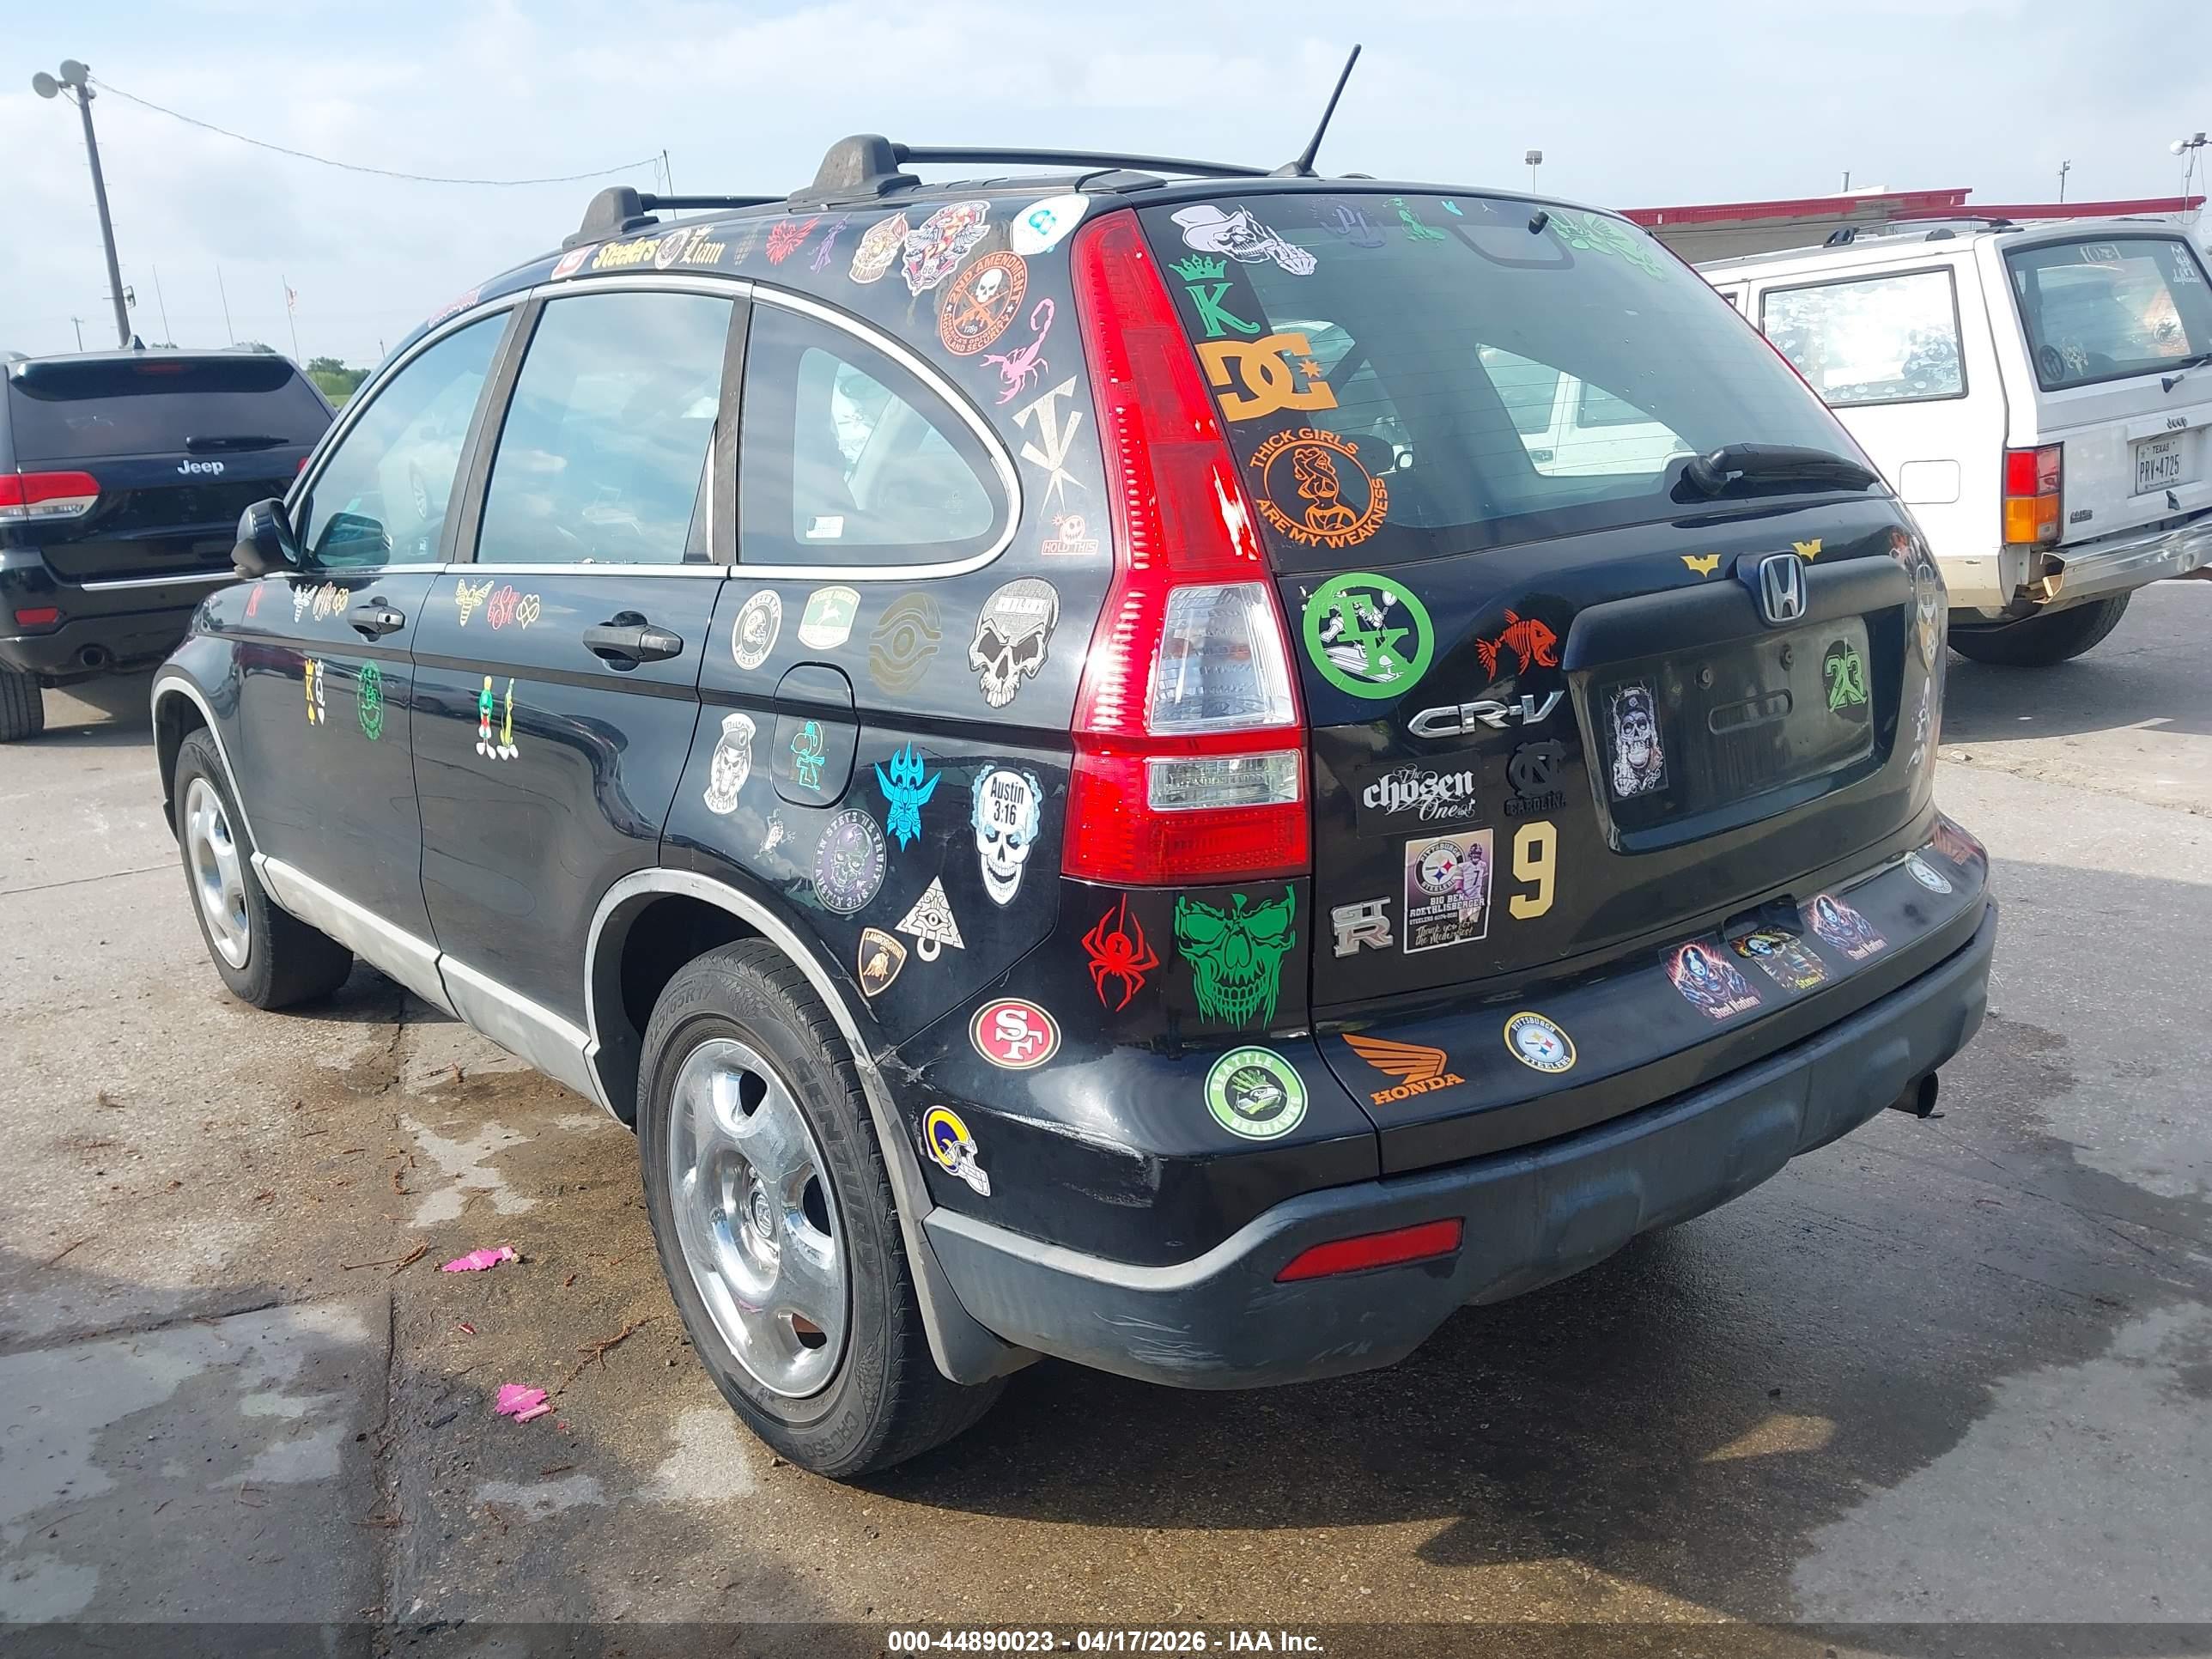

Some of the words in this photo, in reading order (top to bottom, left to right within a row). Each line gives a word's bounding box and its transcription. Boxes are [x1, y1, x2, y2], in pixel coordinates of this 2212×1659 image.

[592, 236, 662, 270] Steelers
[949, 271, 974, 303] 2ND
[975, 253, 1025, 304] AMENDMENT
[1250, 429, 1297, 468] THICK
[1298, 428, 1359, 455] GIRLS
[2152, 443, 2170, 454] TEXAS
[177, 459, 224, 475] Jeep
[1256, 498, 1291, 535] ARE
[1290, 527, 1322, 547] MY
[1323, 477, 1389, 549] WEAKNESS
[1043, 541, 1071, 553] HOLD
[1407, 690, 1565, 739] CR-V
[990, 776, 1024, 805] Austin
[994, 799, 1018, 826] 3:16
[1420, 842, 1462, 862] PITTSBURGH
[1474, 870, 1480, 885] 7
[1509, 820, 1558, 920] 9
[1409, 897, 1486, 918] ROETHLISBERGER
[1430, 896, 1445, 906] BIG
[1447, 893, 1465, 903] BEN
[865, 932, 904, 960] LAMBORGHINI
[1709, 1001, 1734, 1019] Steel
[1729, 995, 1760, 1013] Nation
[1511, 1016, 1557, 1033] PITTSBURGH
[1212, 1053, 1274, 1092] SEATTLE
[1522, 1054, 1571, 1069] STEELERS
[1370, 1073, 1467, 1105] HONDA
[1230, 1096, 1301, 1134] SEAHAWKS
